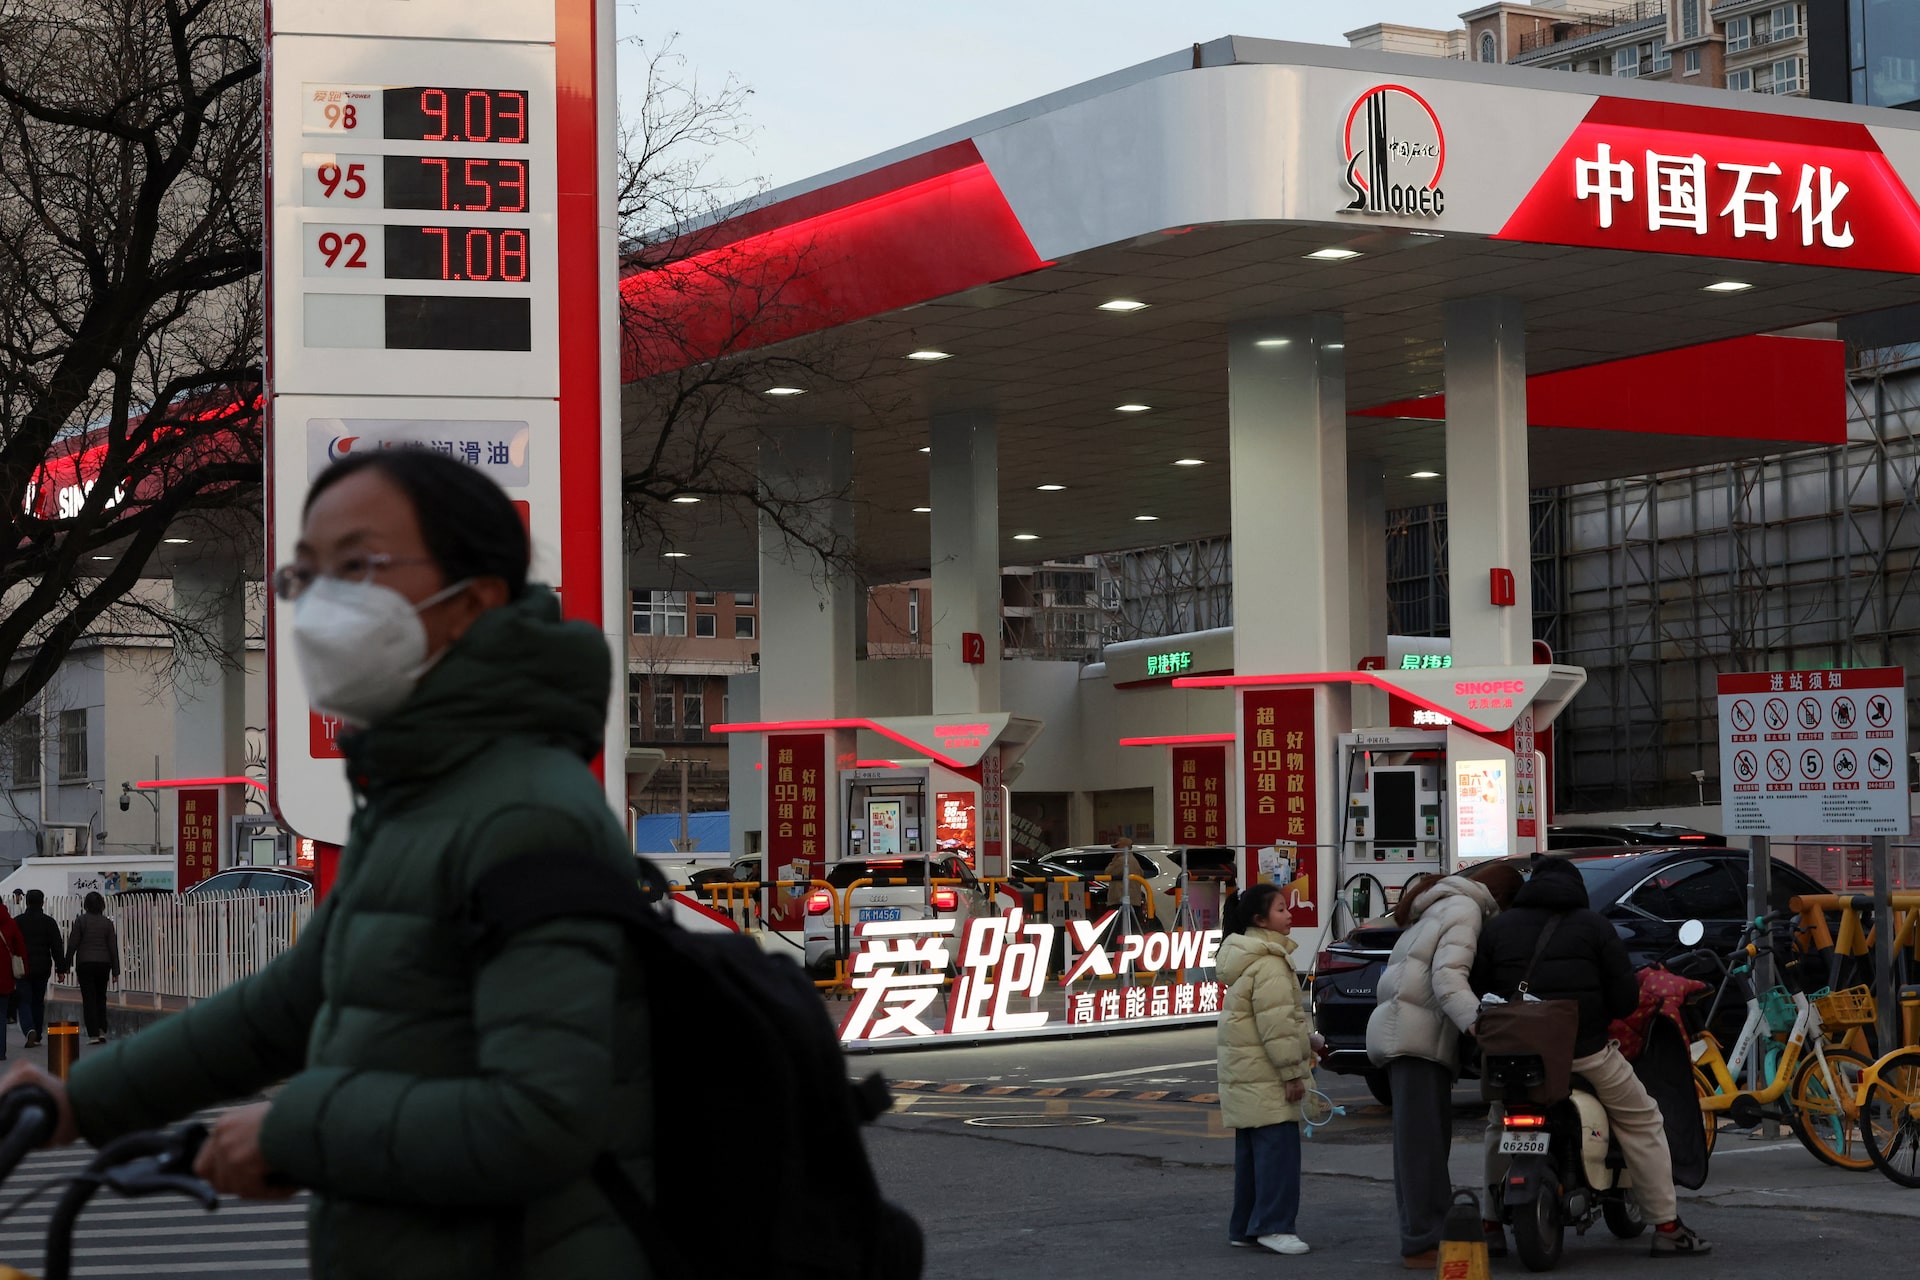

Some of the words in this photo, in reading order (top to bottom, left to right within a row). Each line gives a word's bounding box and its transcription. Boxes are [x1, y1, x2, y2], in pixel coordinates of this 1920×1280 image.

[324, 103, 357, 129] 98
[421, 88, 525, 144] 9.03
[317, 163, 367, 199] 95
[421, 157, 525, 212] 7.53
[1575, 142, 1855, 249] 中国石化
[318, 232, 367, 269] 92
[421, 227, 526, 282] 7.08
[973, 639, 980, 658] 2
[1147, 651, 1191, 675] 易捷养车
[1454, 681, 1525, 696] SINOPEC
[1770, 672, 1842, 691] 进站须知
[1253, 707, 1281, 814] 超值99组合
[1286, 731, 1305, 836] 好物放心选
[1807, 755, 1817, 773] 5
[774, 748, 798, 838] 超值99组合
[801, 768, 817, 856] 好物放心选
[1179, 759, 1201, 839] 超值99组合
[183, 799, 199, 866] 超值99组合
[839, 907, 1055, 1040] 爱跑
[1074, 982, 1229, 1024] 高性能品牌燃
[1503, 1142, 1545, 1152] Q62508
